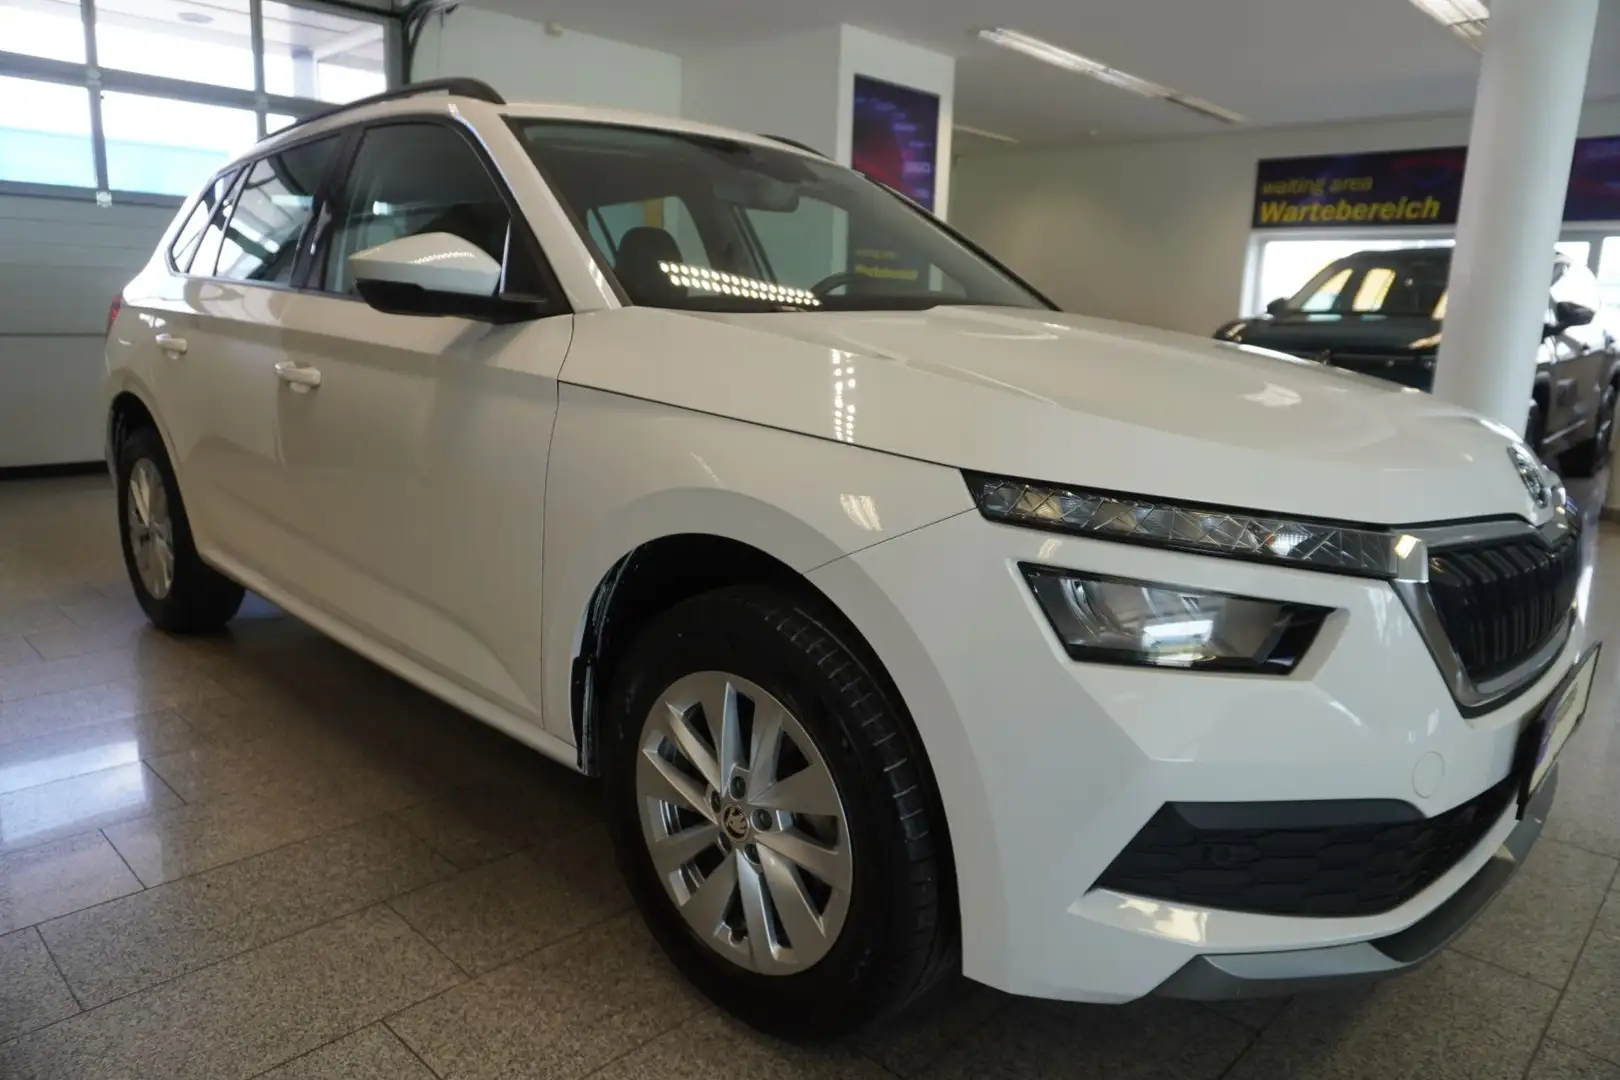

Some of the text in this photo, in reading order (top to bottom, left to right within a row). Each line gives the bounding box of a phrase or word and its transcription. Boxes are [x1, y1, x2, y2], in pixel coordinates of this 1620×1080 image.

[1262, 176, 1373, 196] waiting area
[1259, 196, 1440, 223] Wartebereich
